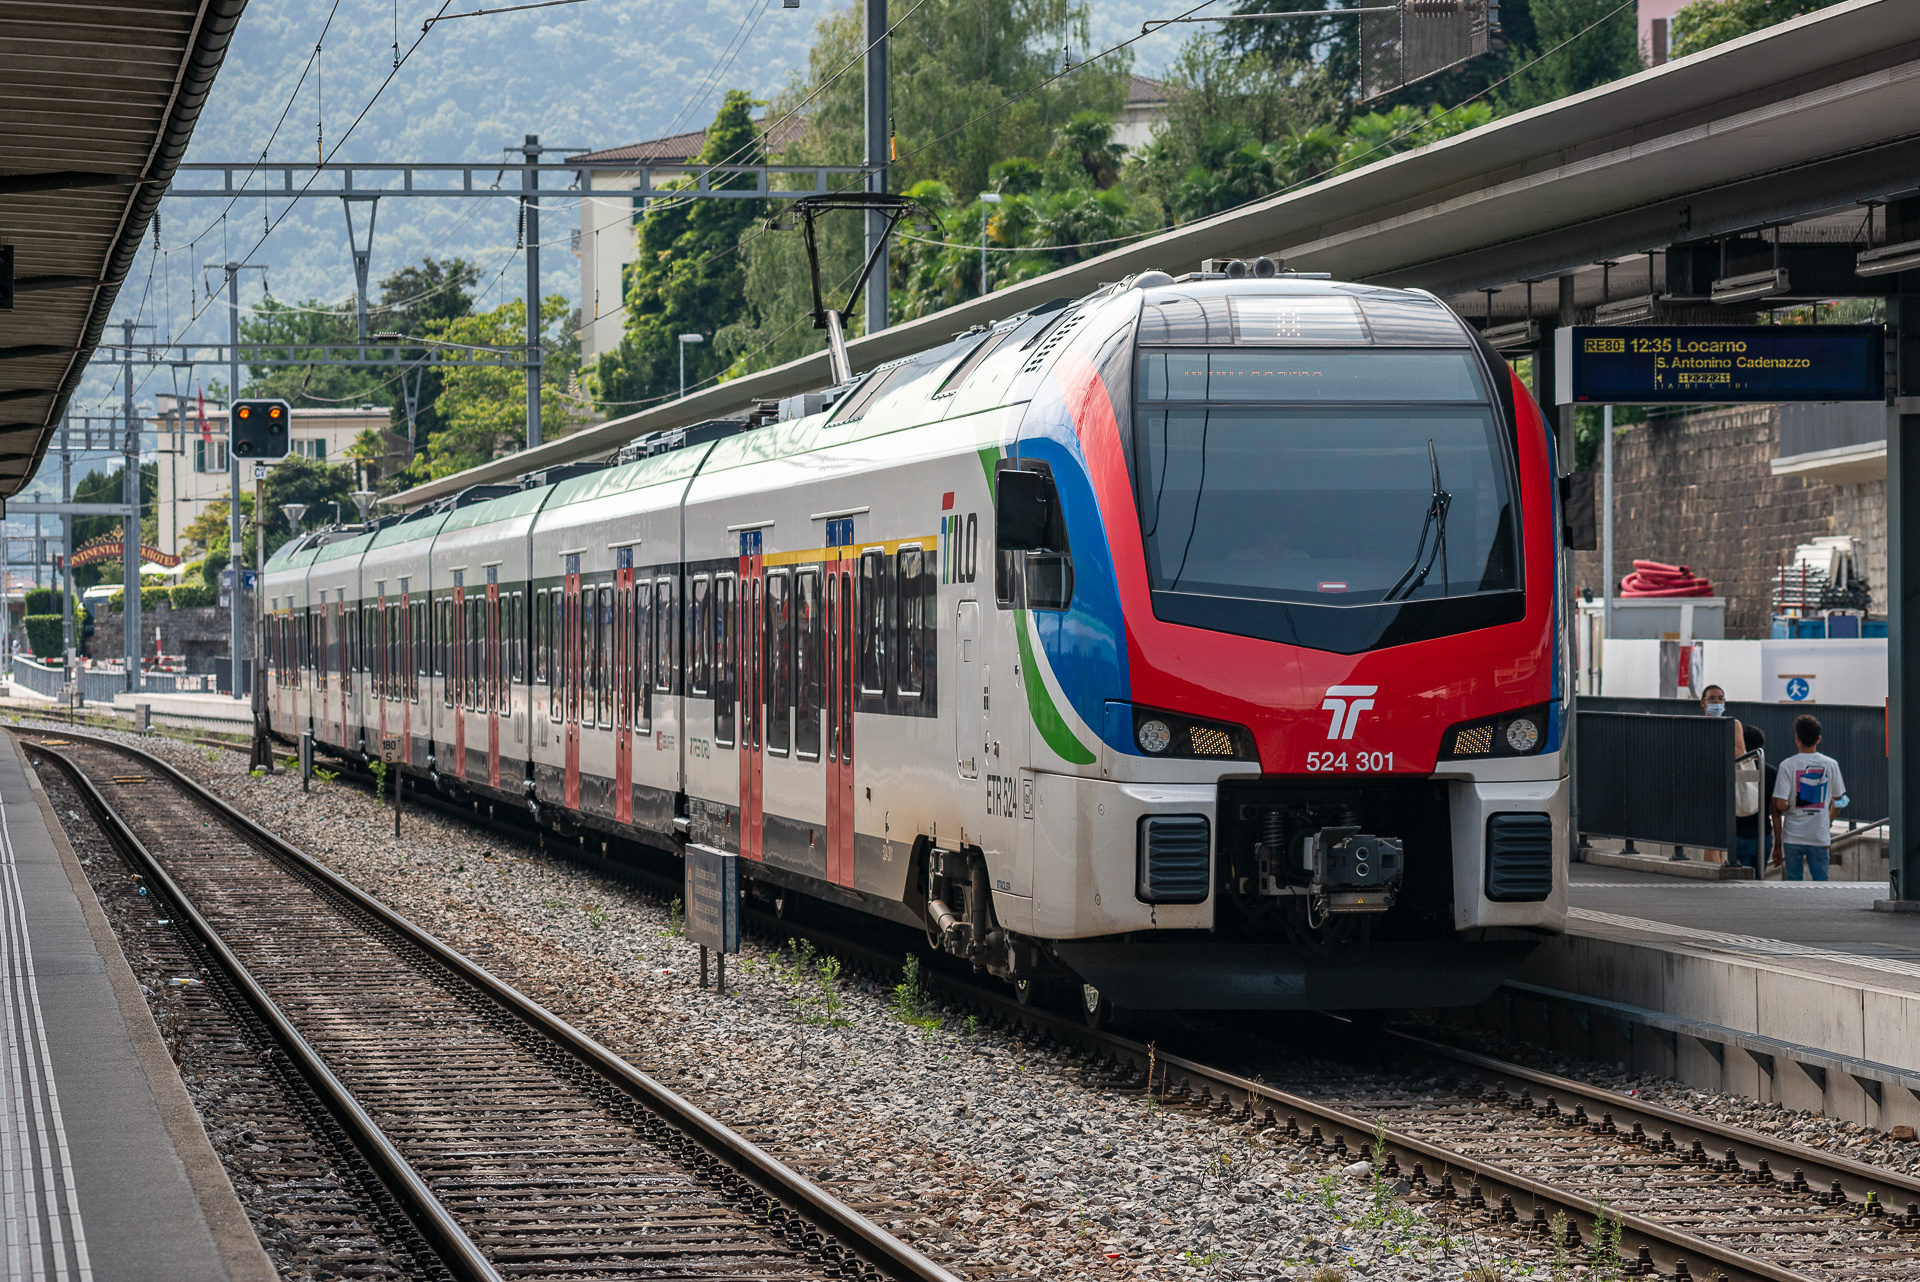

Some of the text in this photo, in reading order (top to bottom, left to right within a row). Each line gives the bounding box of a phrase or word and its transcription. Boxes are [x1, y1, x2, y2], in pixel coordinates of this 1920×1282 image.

[1585, 338, 1747, 353] RE80 12:35 Locarno
[1656, 356, 1810, 368] S. Antonino Cadenazzo
[941, 491, 977, 584] TILO
[62, 543, 121, 567] ONTINENTAL
[382, 740, 396, 750] 180
[385, 752, 392, 762] 5
[1306, 751, 1394, 772] 524 301
[986, 774, 1017, 818] ETR 524
